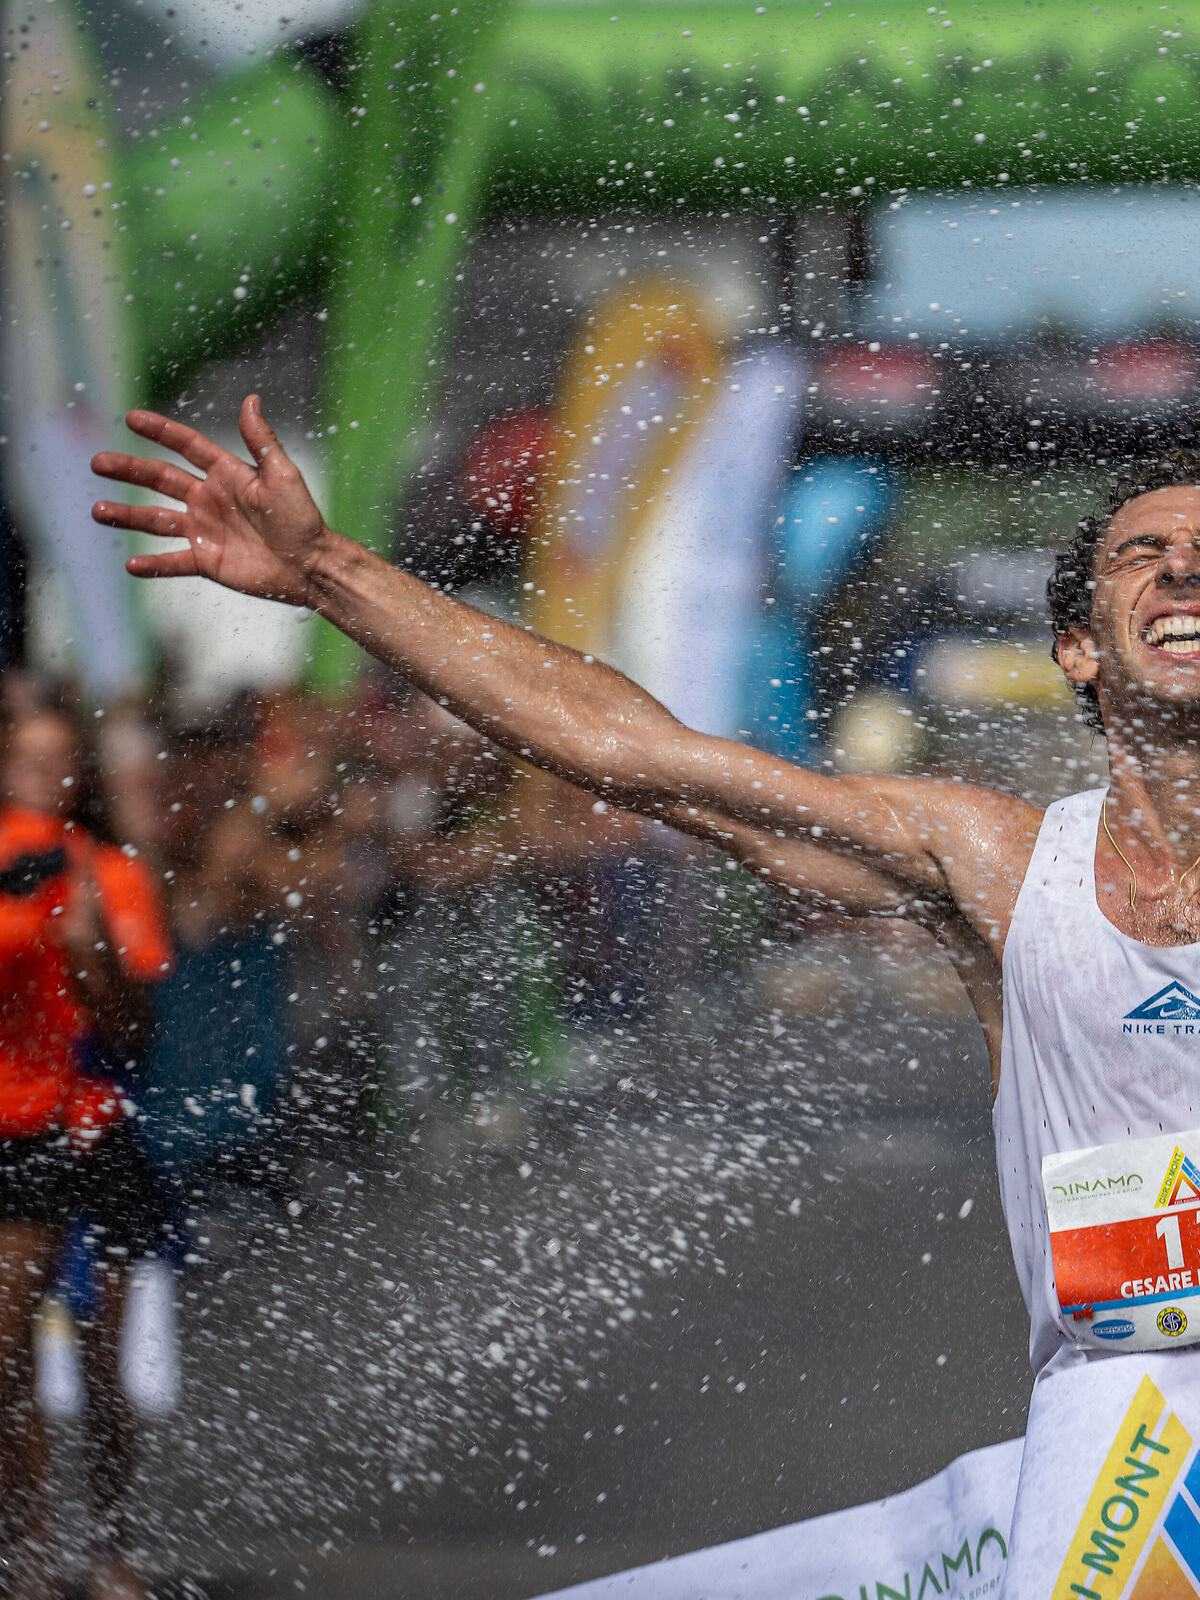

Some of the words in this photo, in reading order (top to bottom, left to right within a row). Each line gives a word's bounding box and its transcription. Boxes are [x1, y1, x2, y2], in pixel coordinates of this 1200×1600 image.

[1122, 1023, 1165, 1034] NIKE
[1120, 1270, 1194, 1299] CESARE
[1080, 1423, 1171, 1576] MONT
